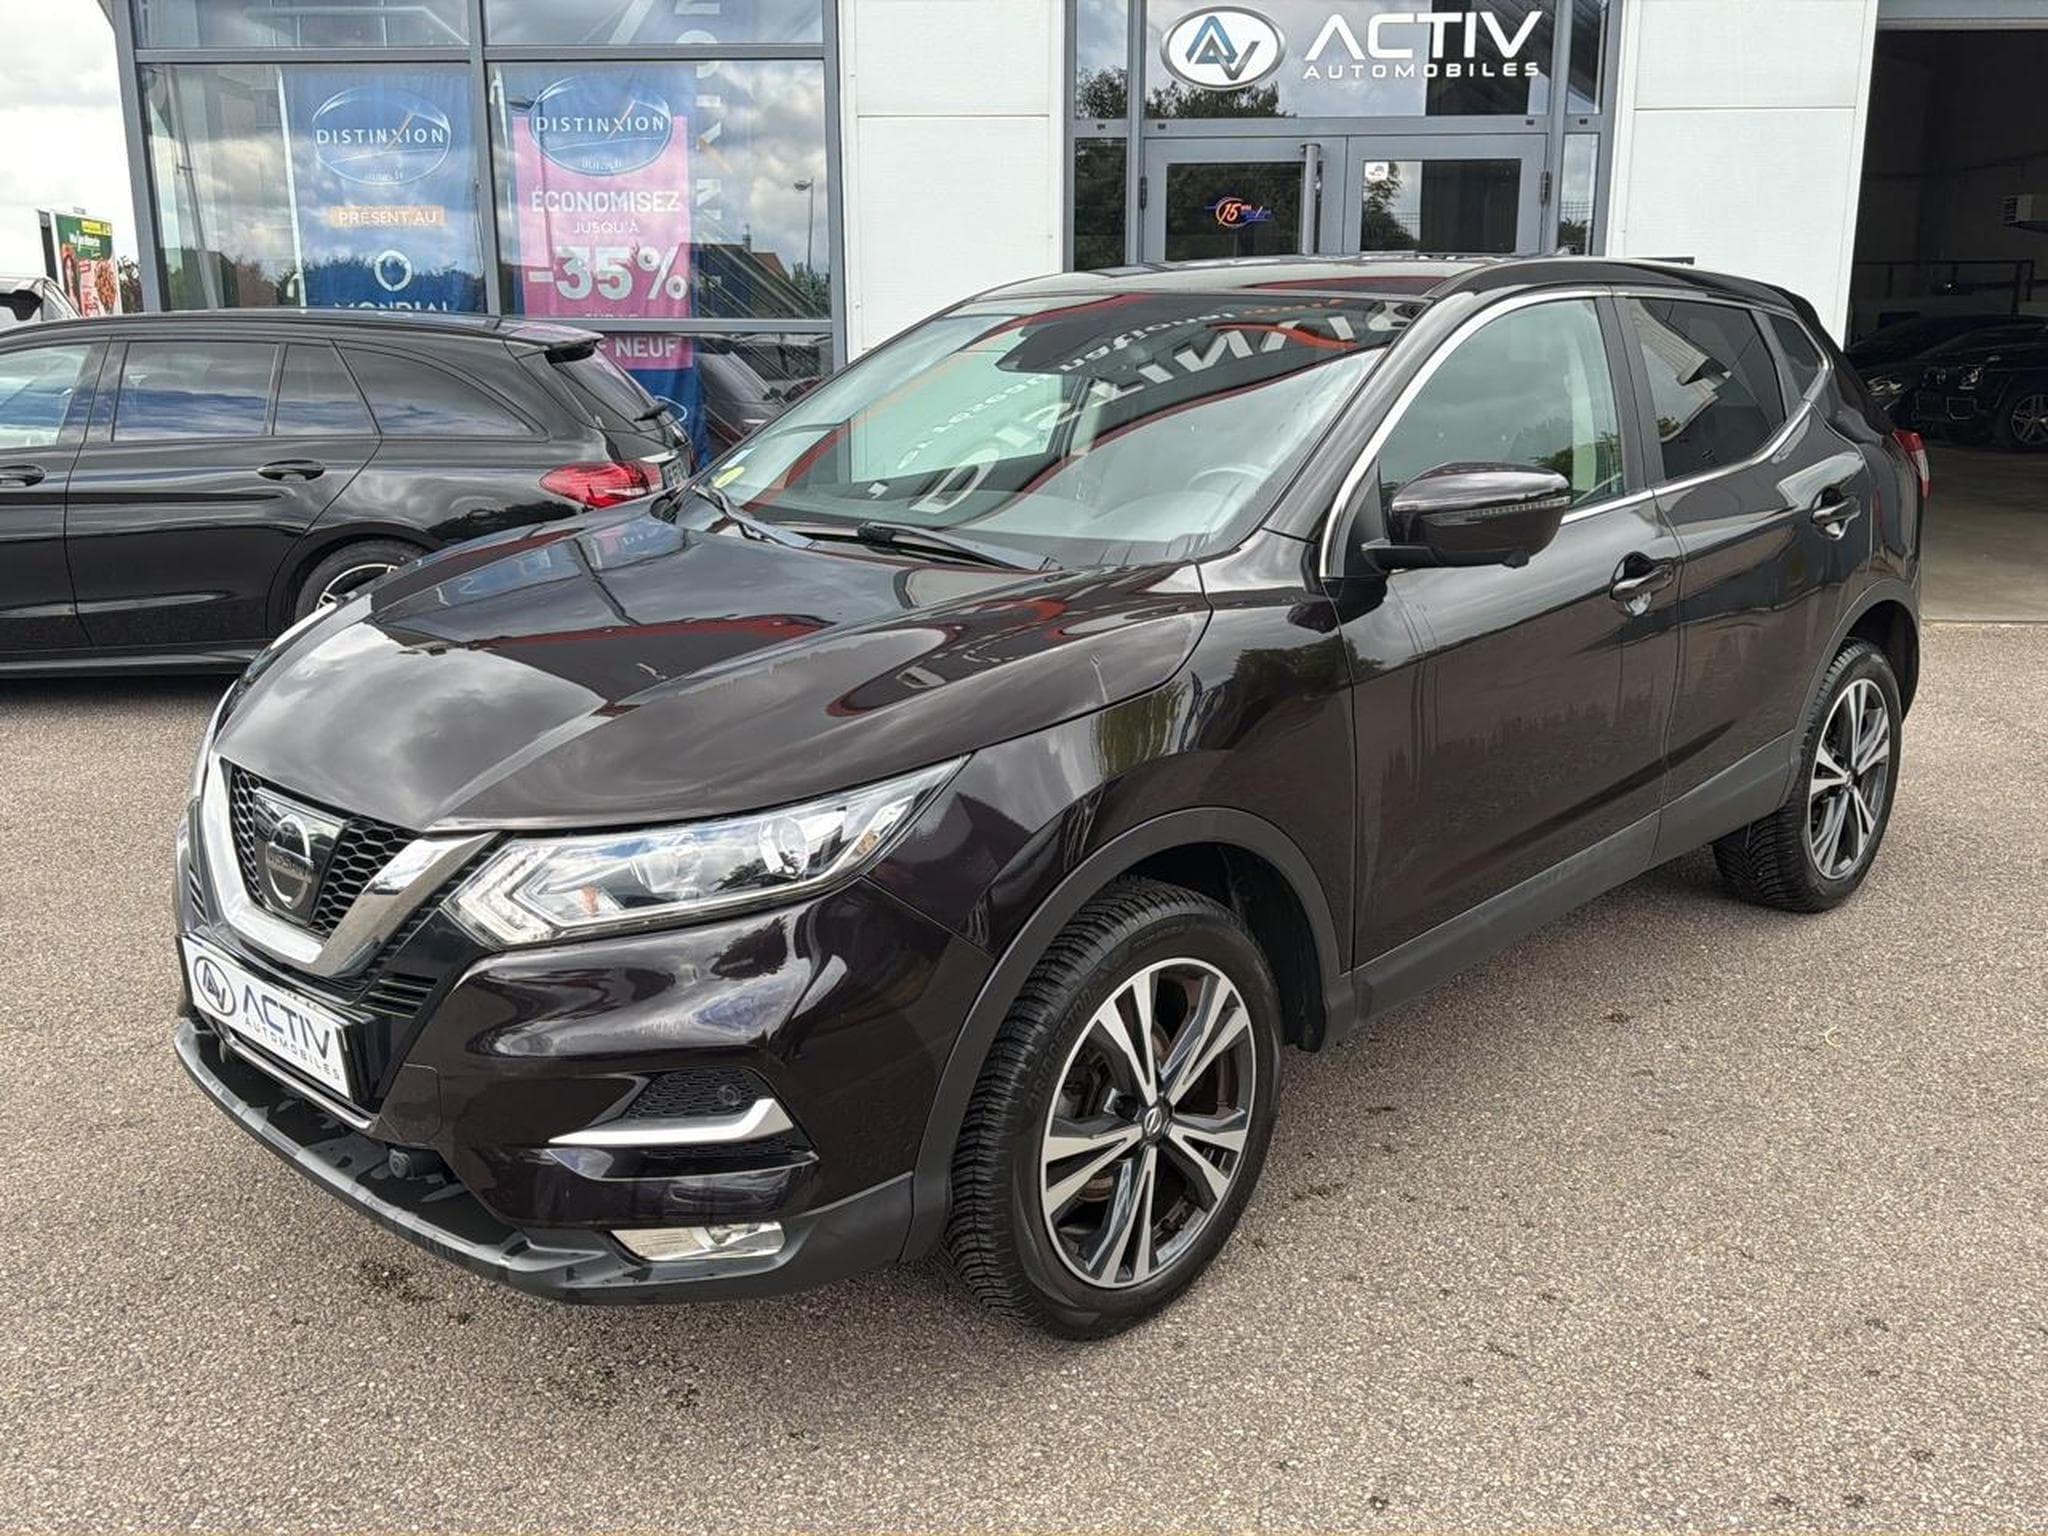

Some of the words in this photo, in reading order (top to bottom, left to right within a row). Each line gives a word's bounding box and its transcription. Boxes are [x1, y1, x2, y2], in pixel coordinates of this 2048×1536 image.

[1304, 10, 1543, 61] ACTIV
[1303, 62, 1540, 80] AUTOMOBILES
[535, 116, 664, 133] DISTINXION
[316, 127, 445, 145] DISTINXION
[531, 185, 680, 213] ÉCONOMISEZ
[414, 210, 437, 224] AU
[528, 246, 688, 301] -35%
[615, 336, 677, 358] NEUF
[243, 984, 330, 1060] ACTIV
